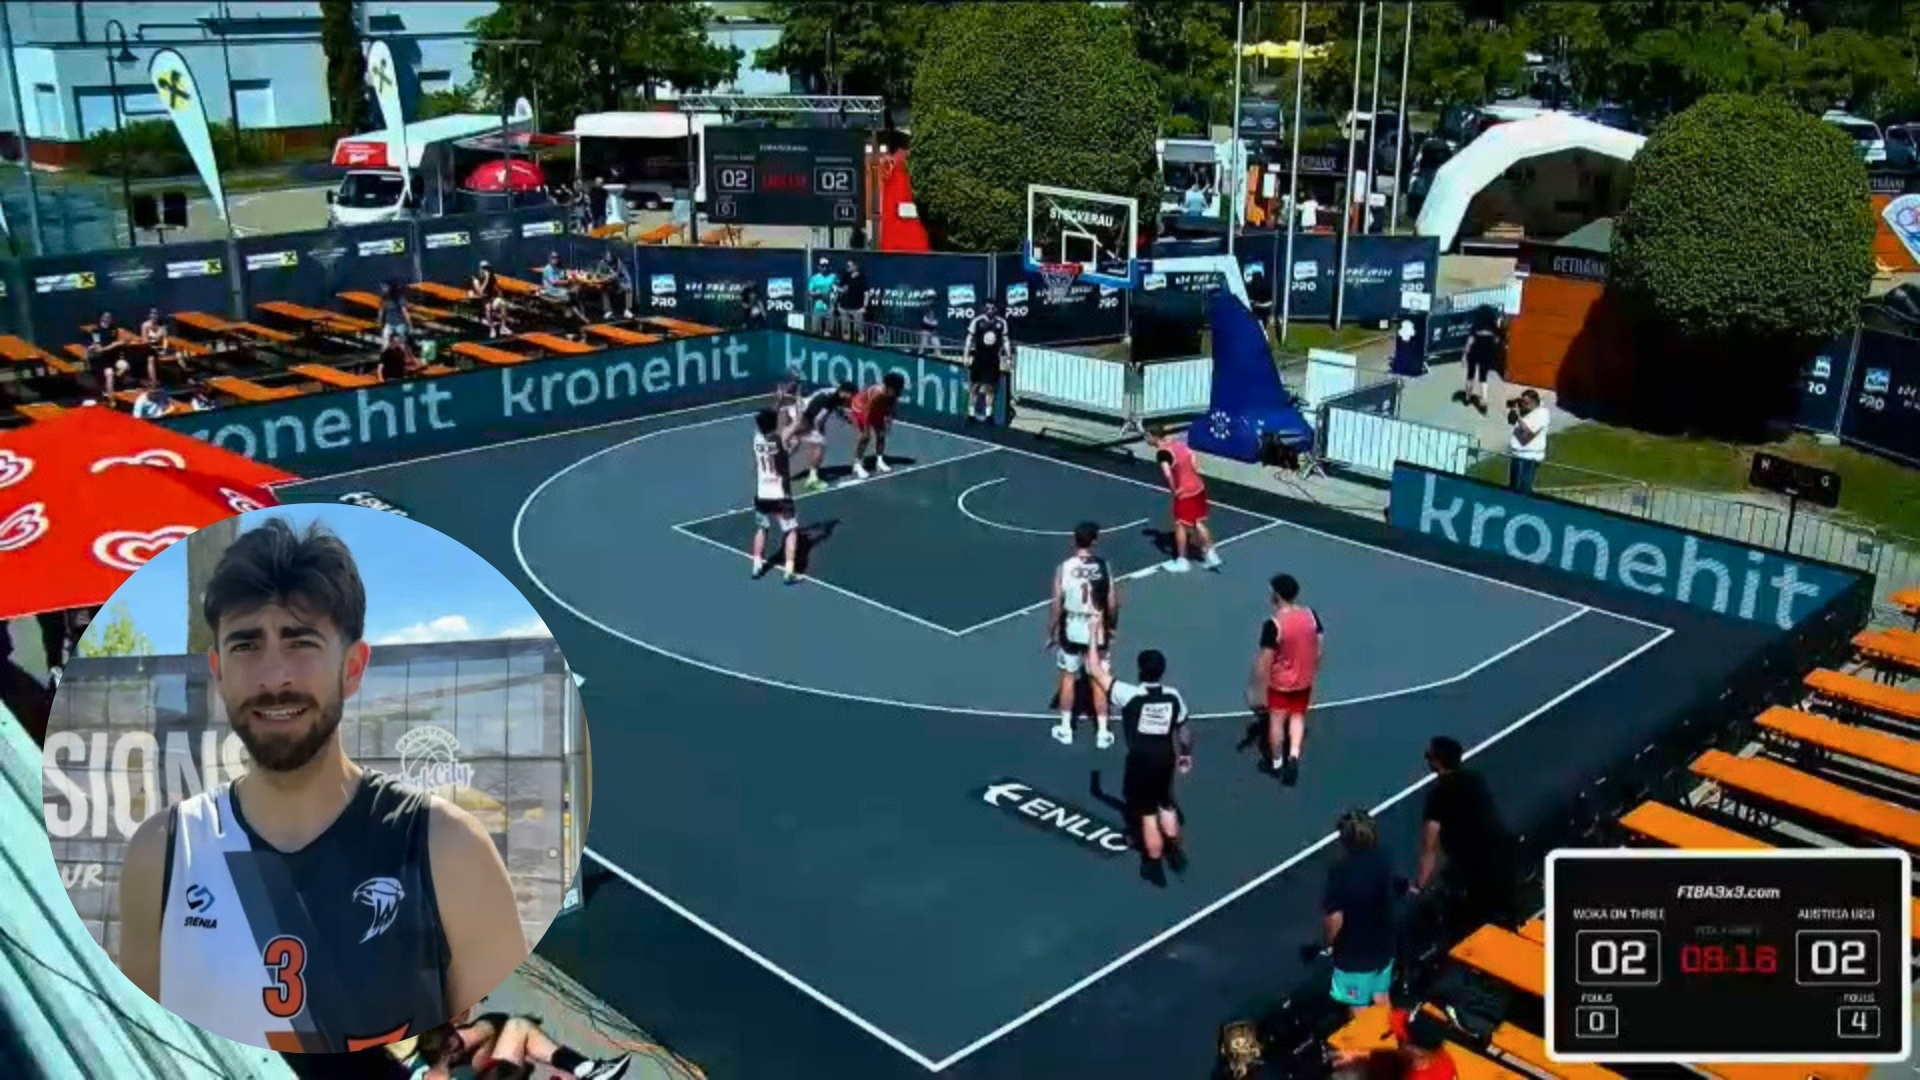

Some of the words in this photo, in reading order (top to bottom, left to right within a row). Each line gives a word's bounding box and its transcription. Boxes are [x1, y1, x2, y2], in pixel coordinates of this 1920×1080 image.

[721, 169, 748, 188] 02
[821, 171, 849, 190] 02
[1291, 281, 1317, 292] PRO
[651, 296, 677, 307] PRO
[767, 300, 794, 312] PRO
[947, 307, 975, 319] PRO
[1005, 307, 1029, 318] PRO
[503, 335, 749, 417] kronehit
[785, 333, 969, 415] kronehi
[1419, 474, 1821, 632] kronehit
[262, 934, 307, 1020] 3
